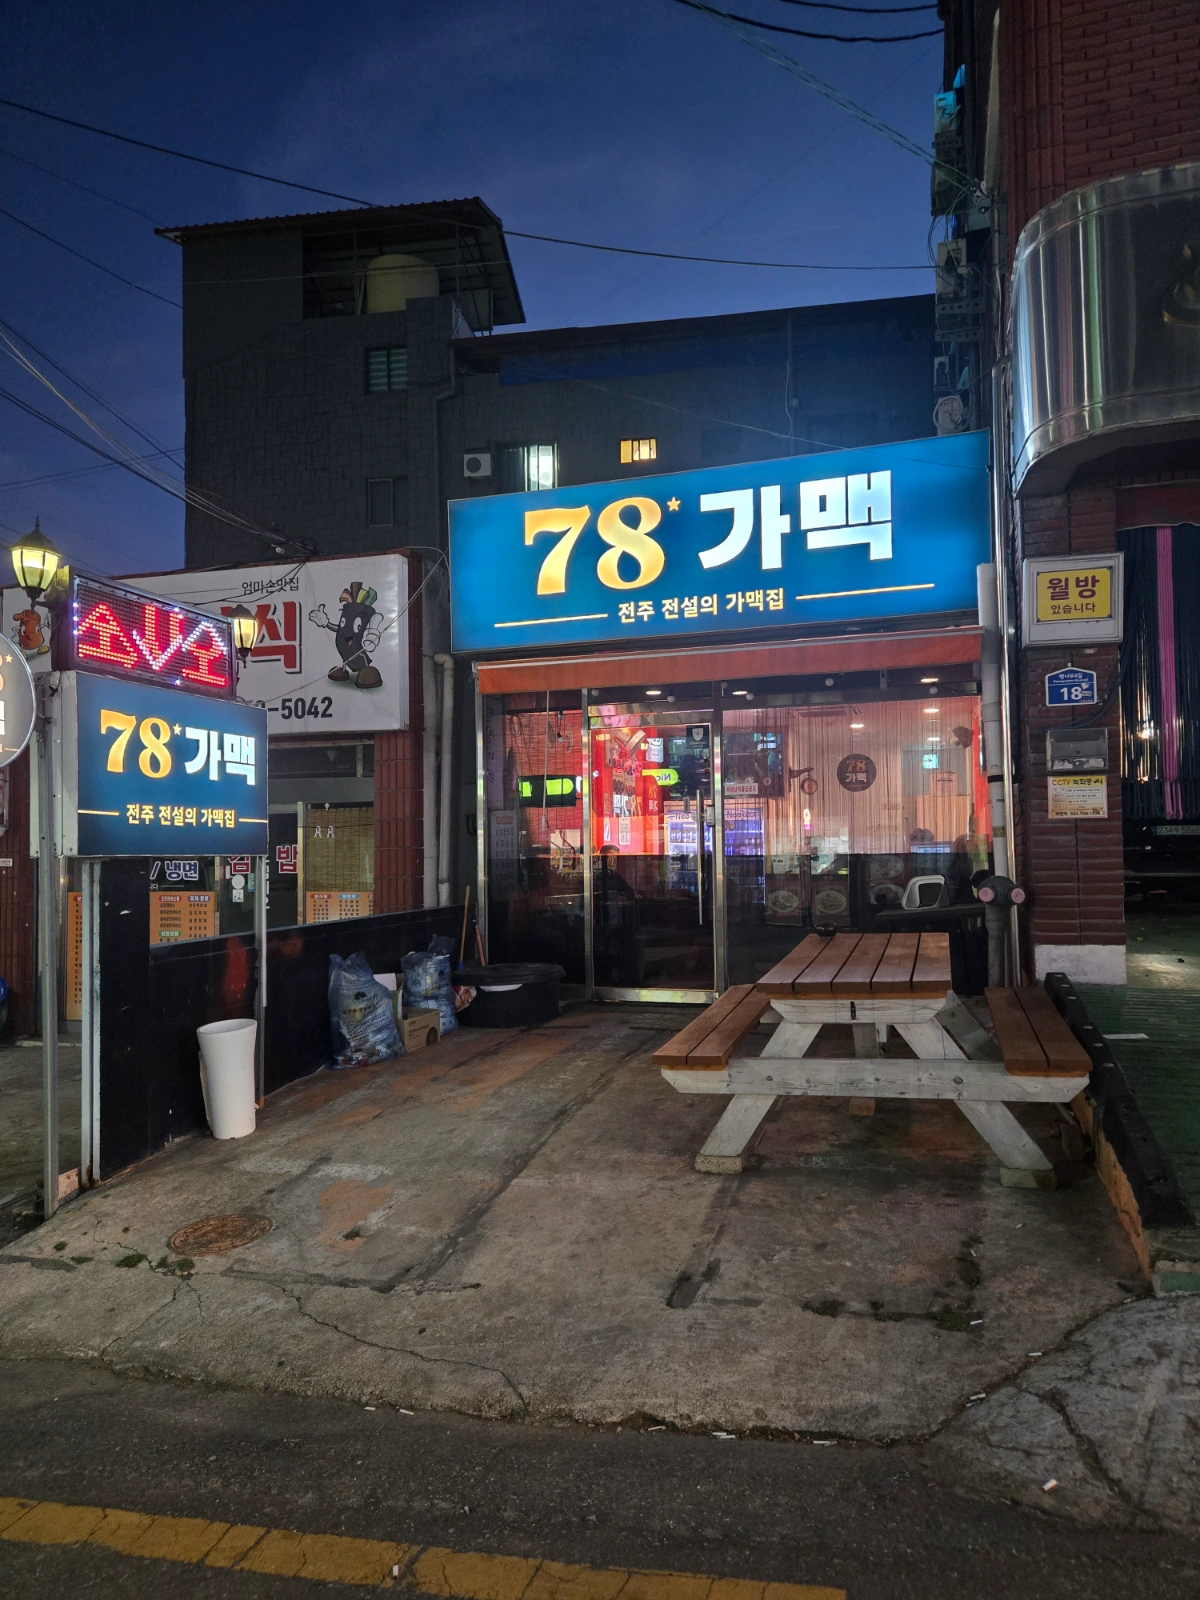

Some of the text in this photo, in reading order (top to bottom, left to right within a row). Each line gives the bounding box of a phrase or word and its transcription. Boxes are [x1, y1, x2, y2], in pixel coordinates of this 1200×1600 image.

[524, 470, 893, 596] 78 가맥
[242, 577, 299, 595] 엄마손맛집
[1047, 575, 1100, 600] 월방
[617, 588, 785, 624] 전주 전설의 가맥집
[1051, 602, 1096, 616] 있습니다
[221, 601, 302, 674] 식
[1060, 687, 1082, 700] 18
[100, 709, 255, 785] 78 가맥
[846, 760, 867, 772] 78
[846, 772, 867, 782] 가맥
[126, 804, 235, 828] 전주 전설의 가맥집
[164, 860, 199, 881] 냉면
